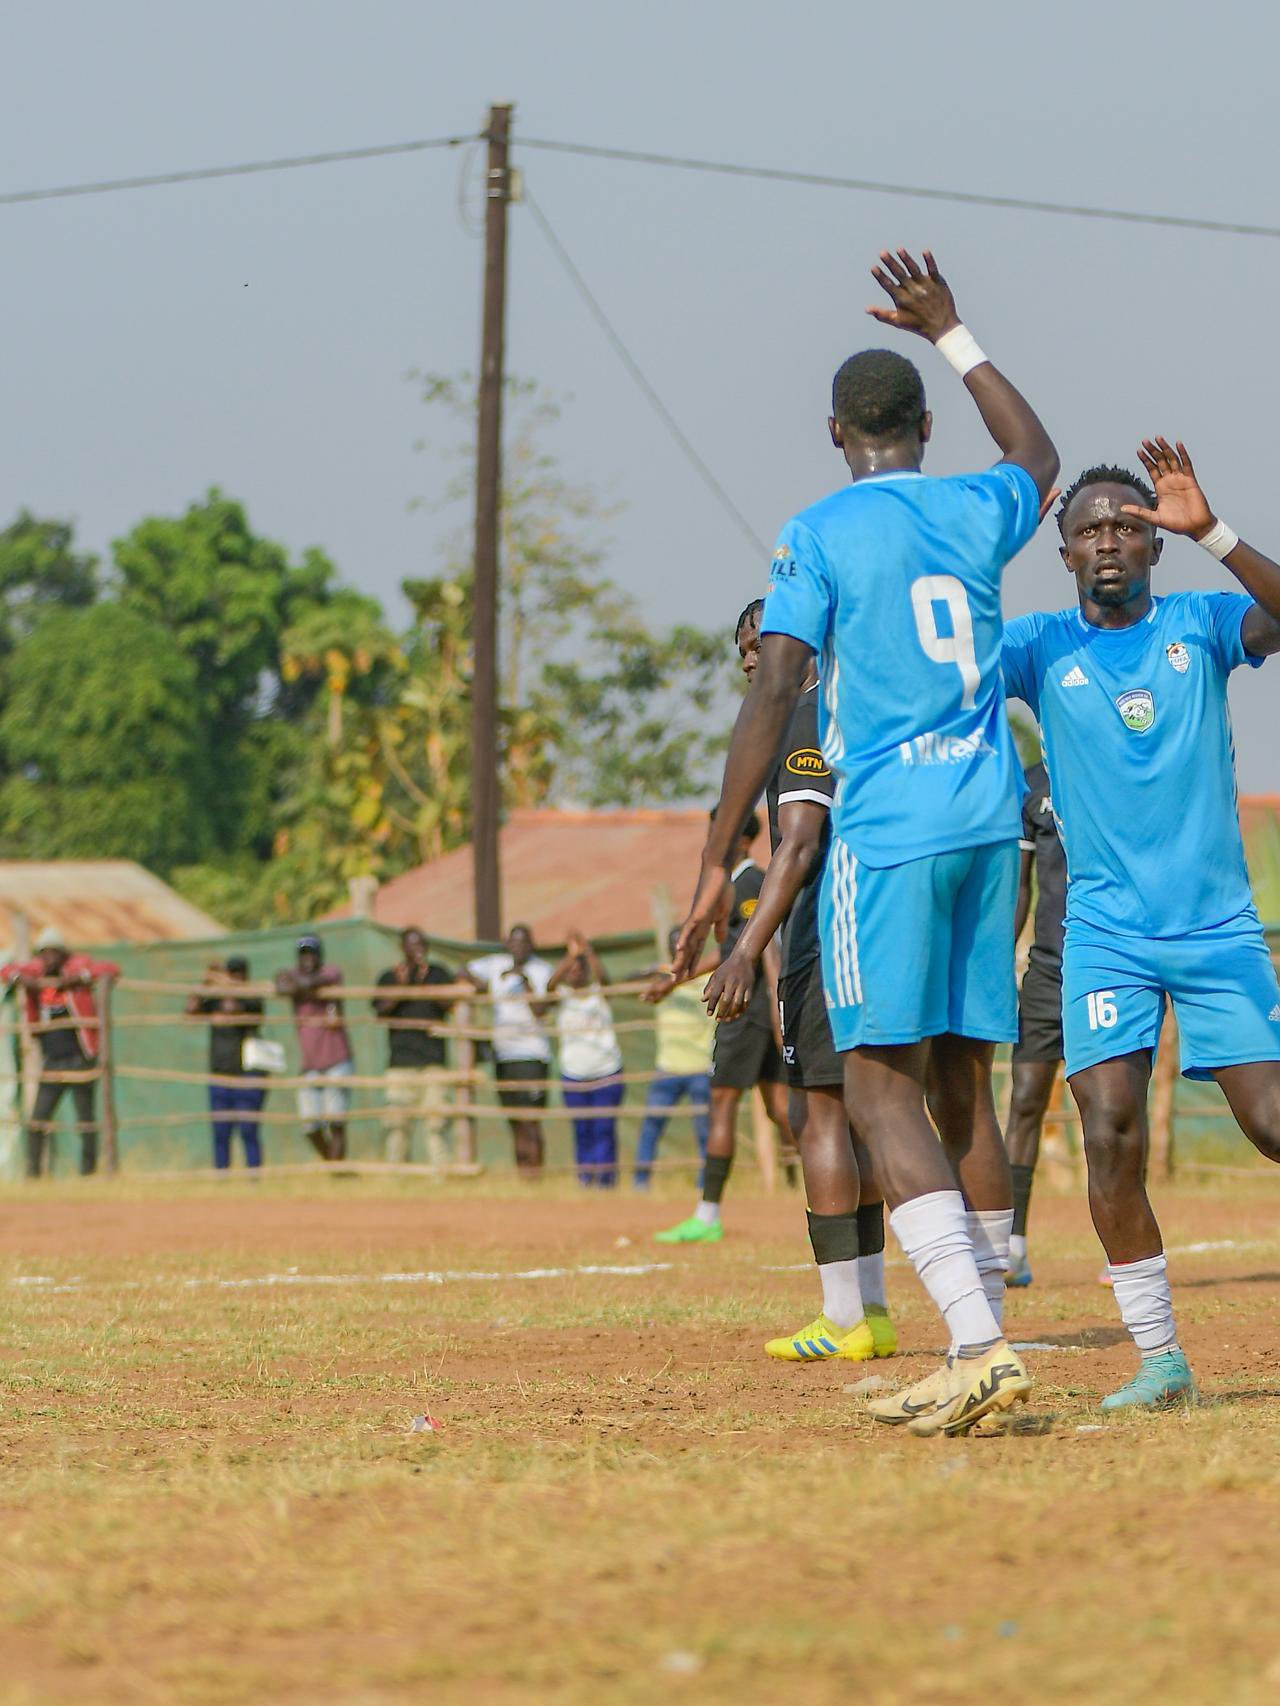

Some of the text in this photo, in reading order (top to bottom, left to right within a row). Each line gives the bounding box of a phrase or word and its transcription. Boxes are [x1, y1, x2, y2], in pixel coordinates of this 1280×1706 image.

[771, 561, 797, 576] ILE
[911, 575, 981, 710] 9
[797, 756, 822, 770] MTN
[1087, 991, 1118, 1030] 16
